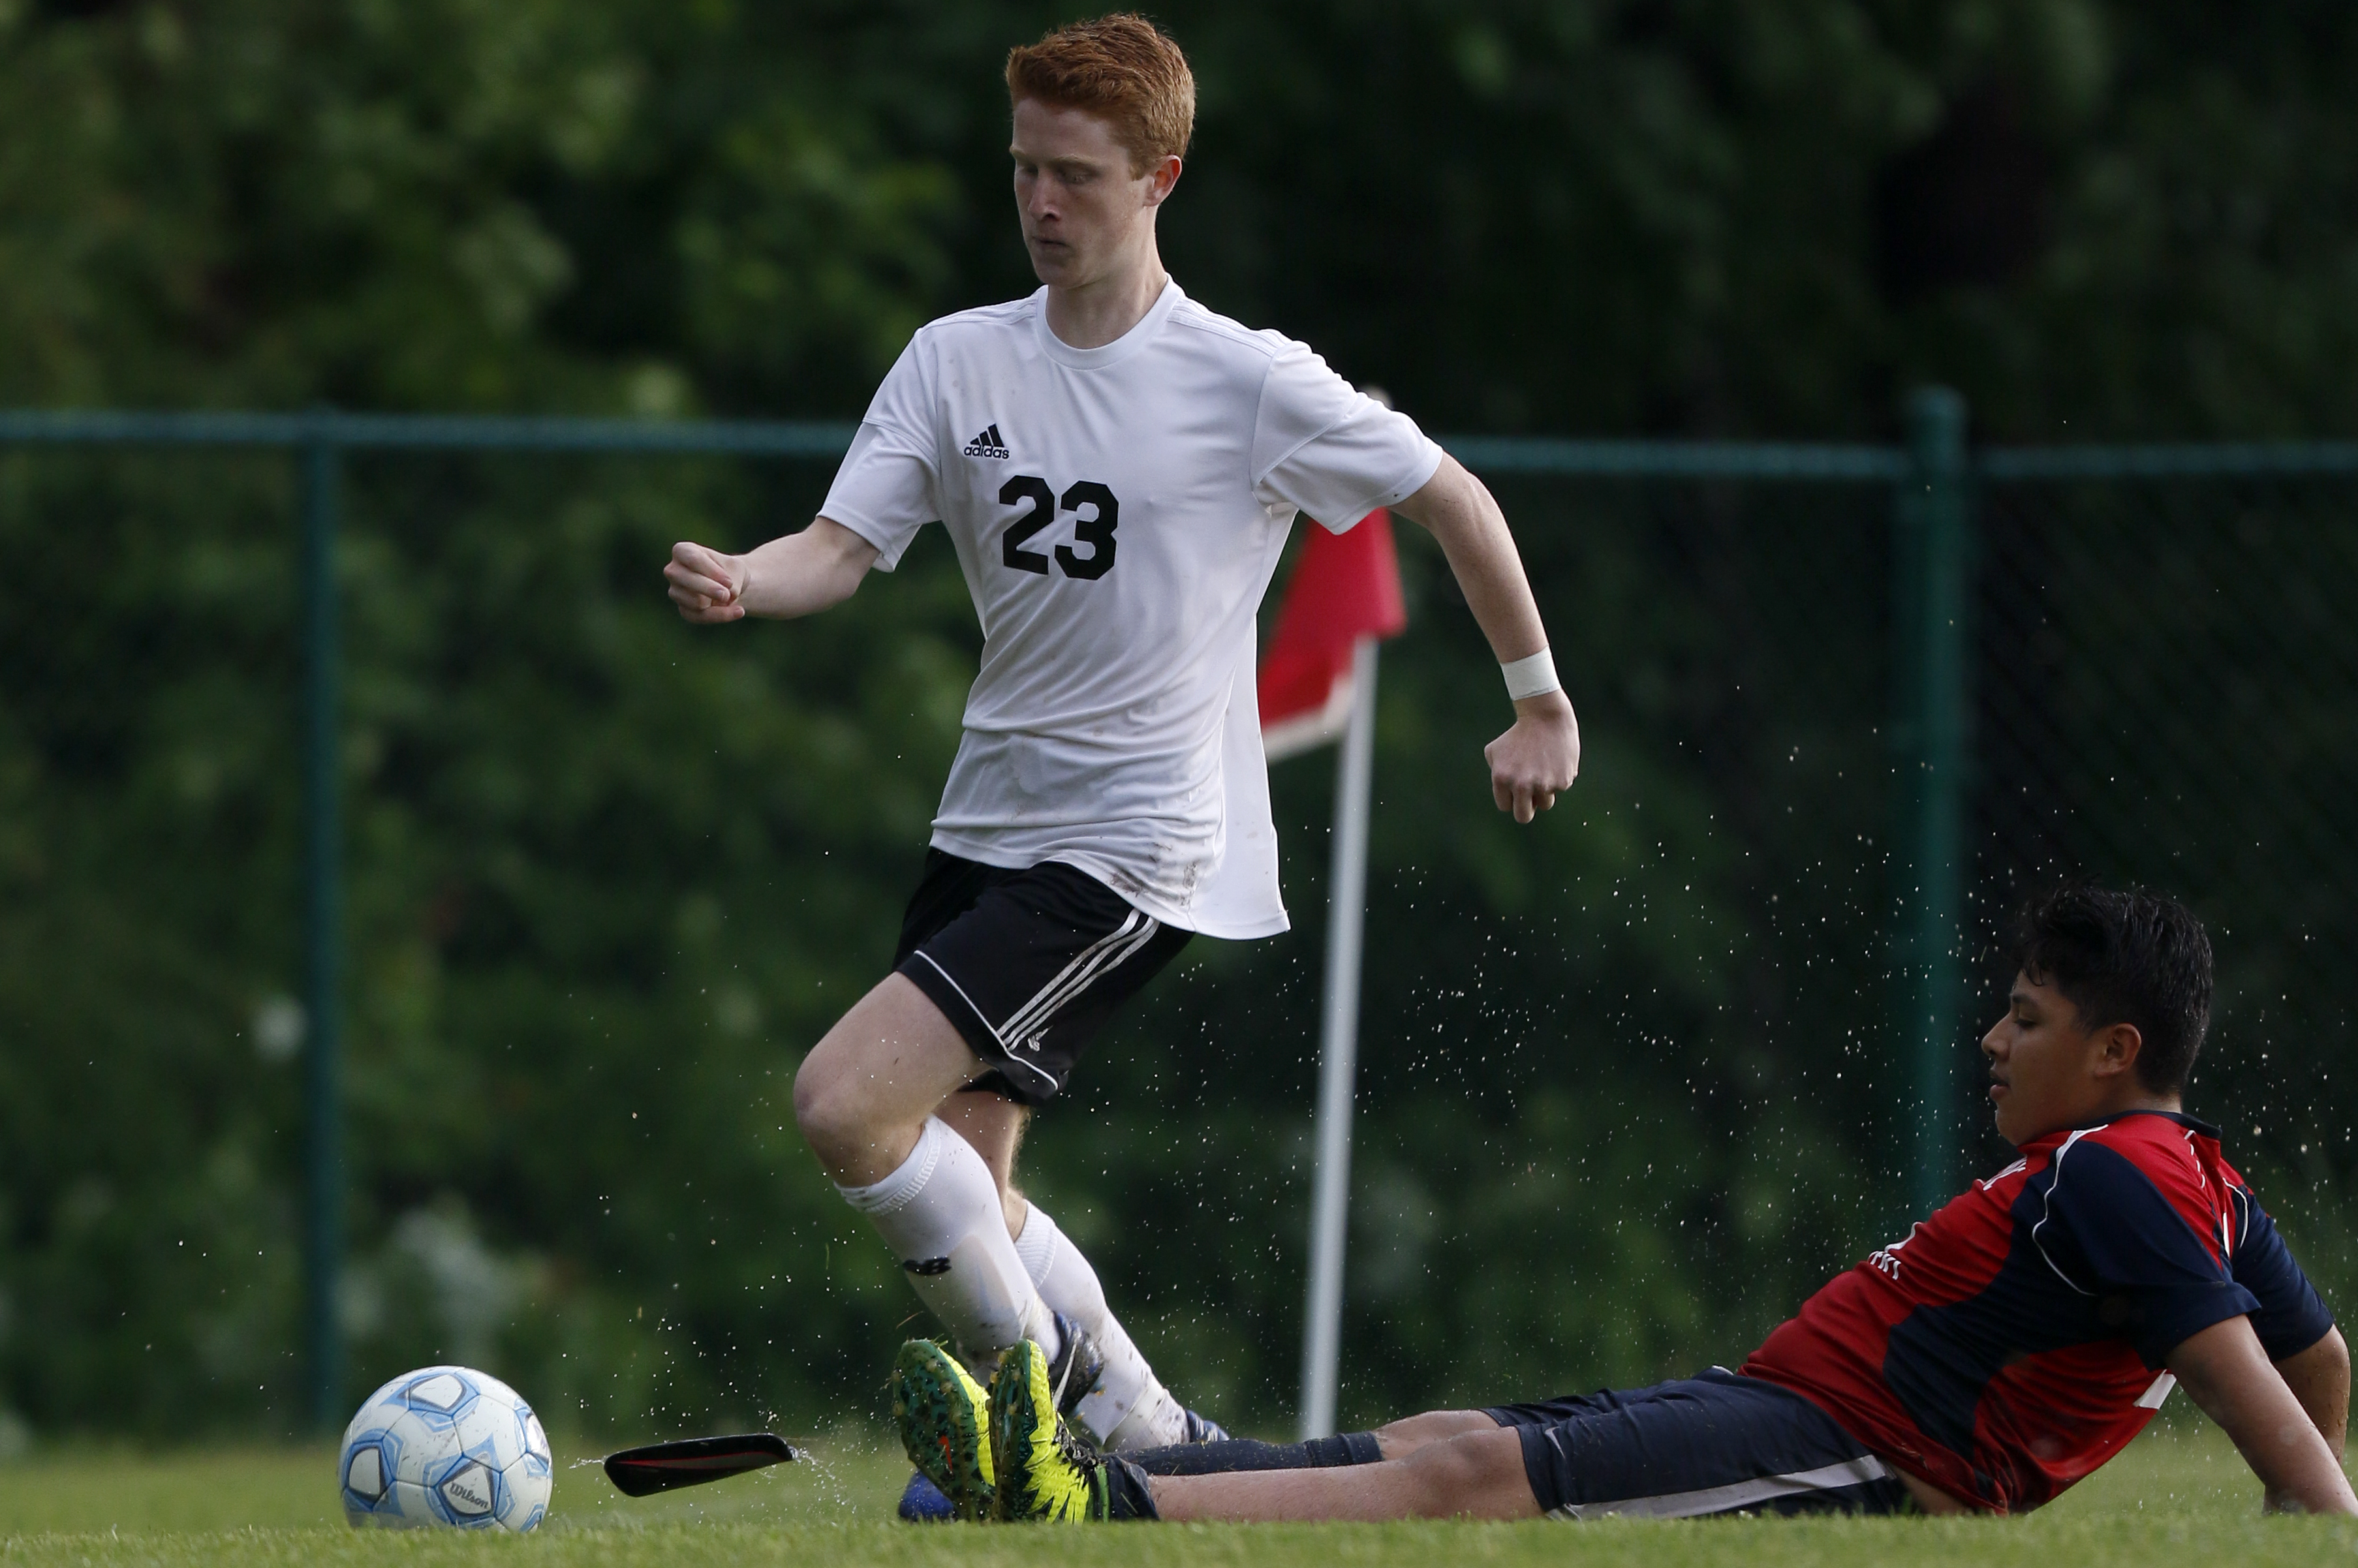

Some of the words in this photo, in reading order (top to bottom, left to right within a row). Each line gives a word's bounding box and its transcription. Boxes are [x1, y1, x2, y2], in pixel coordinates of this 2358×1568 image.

[964, 444, 1009, 459] adidas
[999, 475, 1119, 580] 23
[450, 1483, 489, 1508] Wilson
